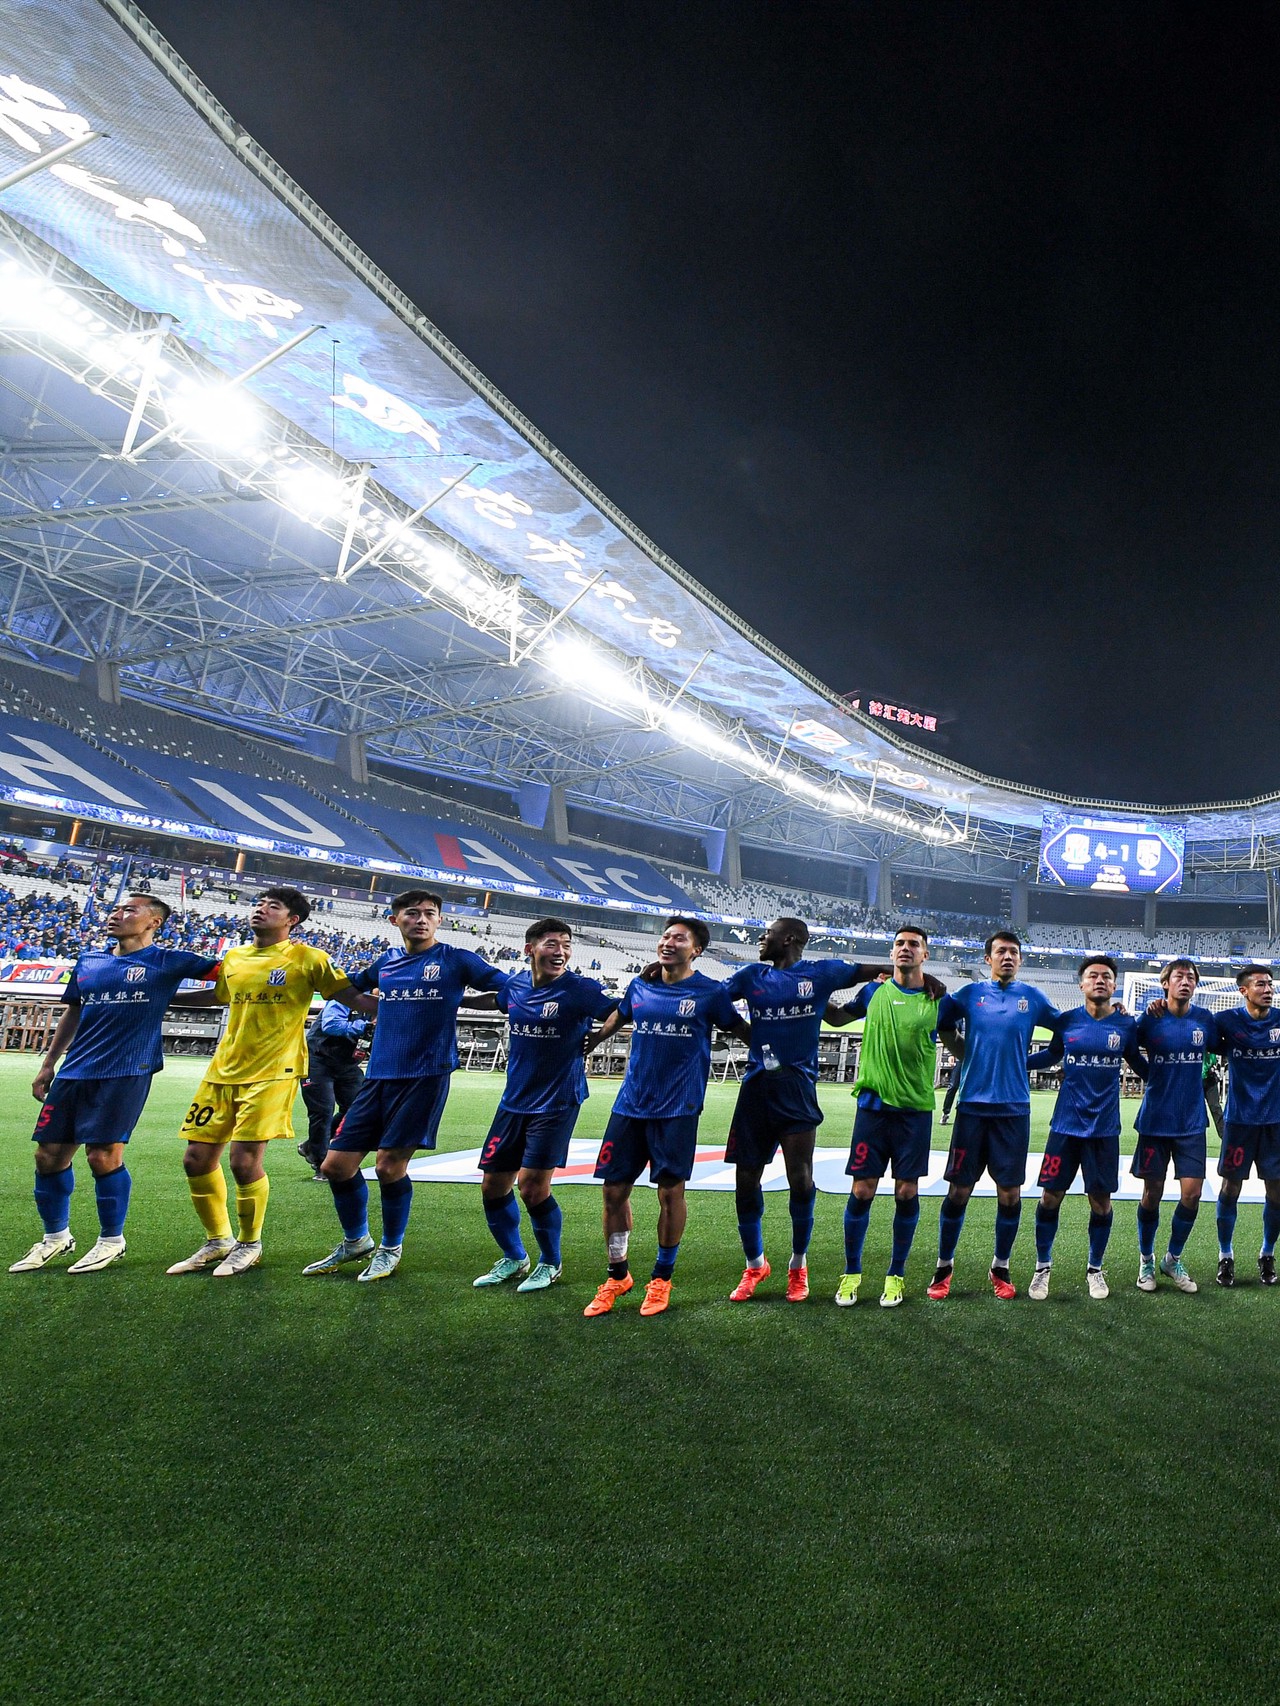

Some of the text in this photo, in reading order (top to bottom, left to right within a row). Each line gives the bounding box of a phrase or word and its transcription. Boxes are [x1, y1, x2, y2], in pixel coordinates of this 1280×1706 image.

[552, 856, 672, 905] FC
[26, 968, 52, 982] AND
[185, 1102, 215, 1127] 30
[484, 1135, 502, 1158] 5
[854, 1142, 869, 1165] 9
[1041, 1153, 1061, 1177] 28
